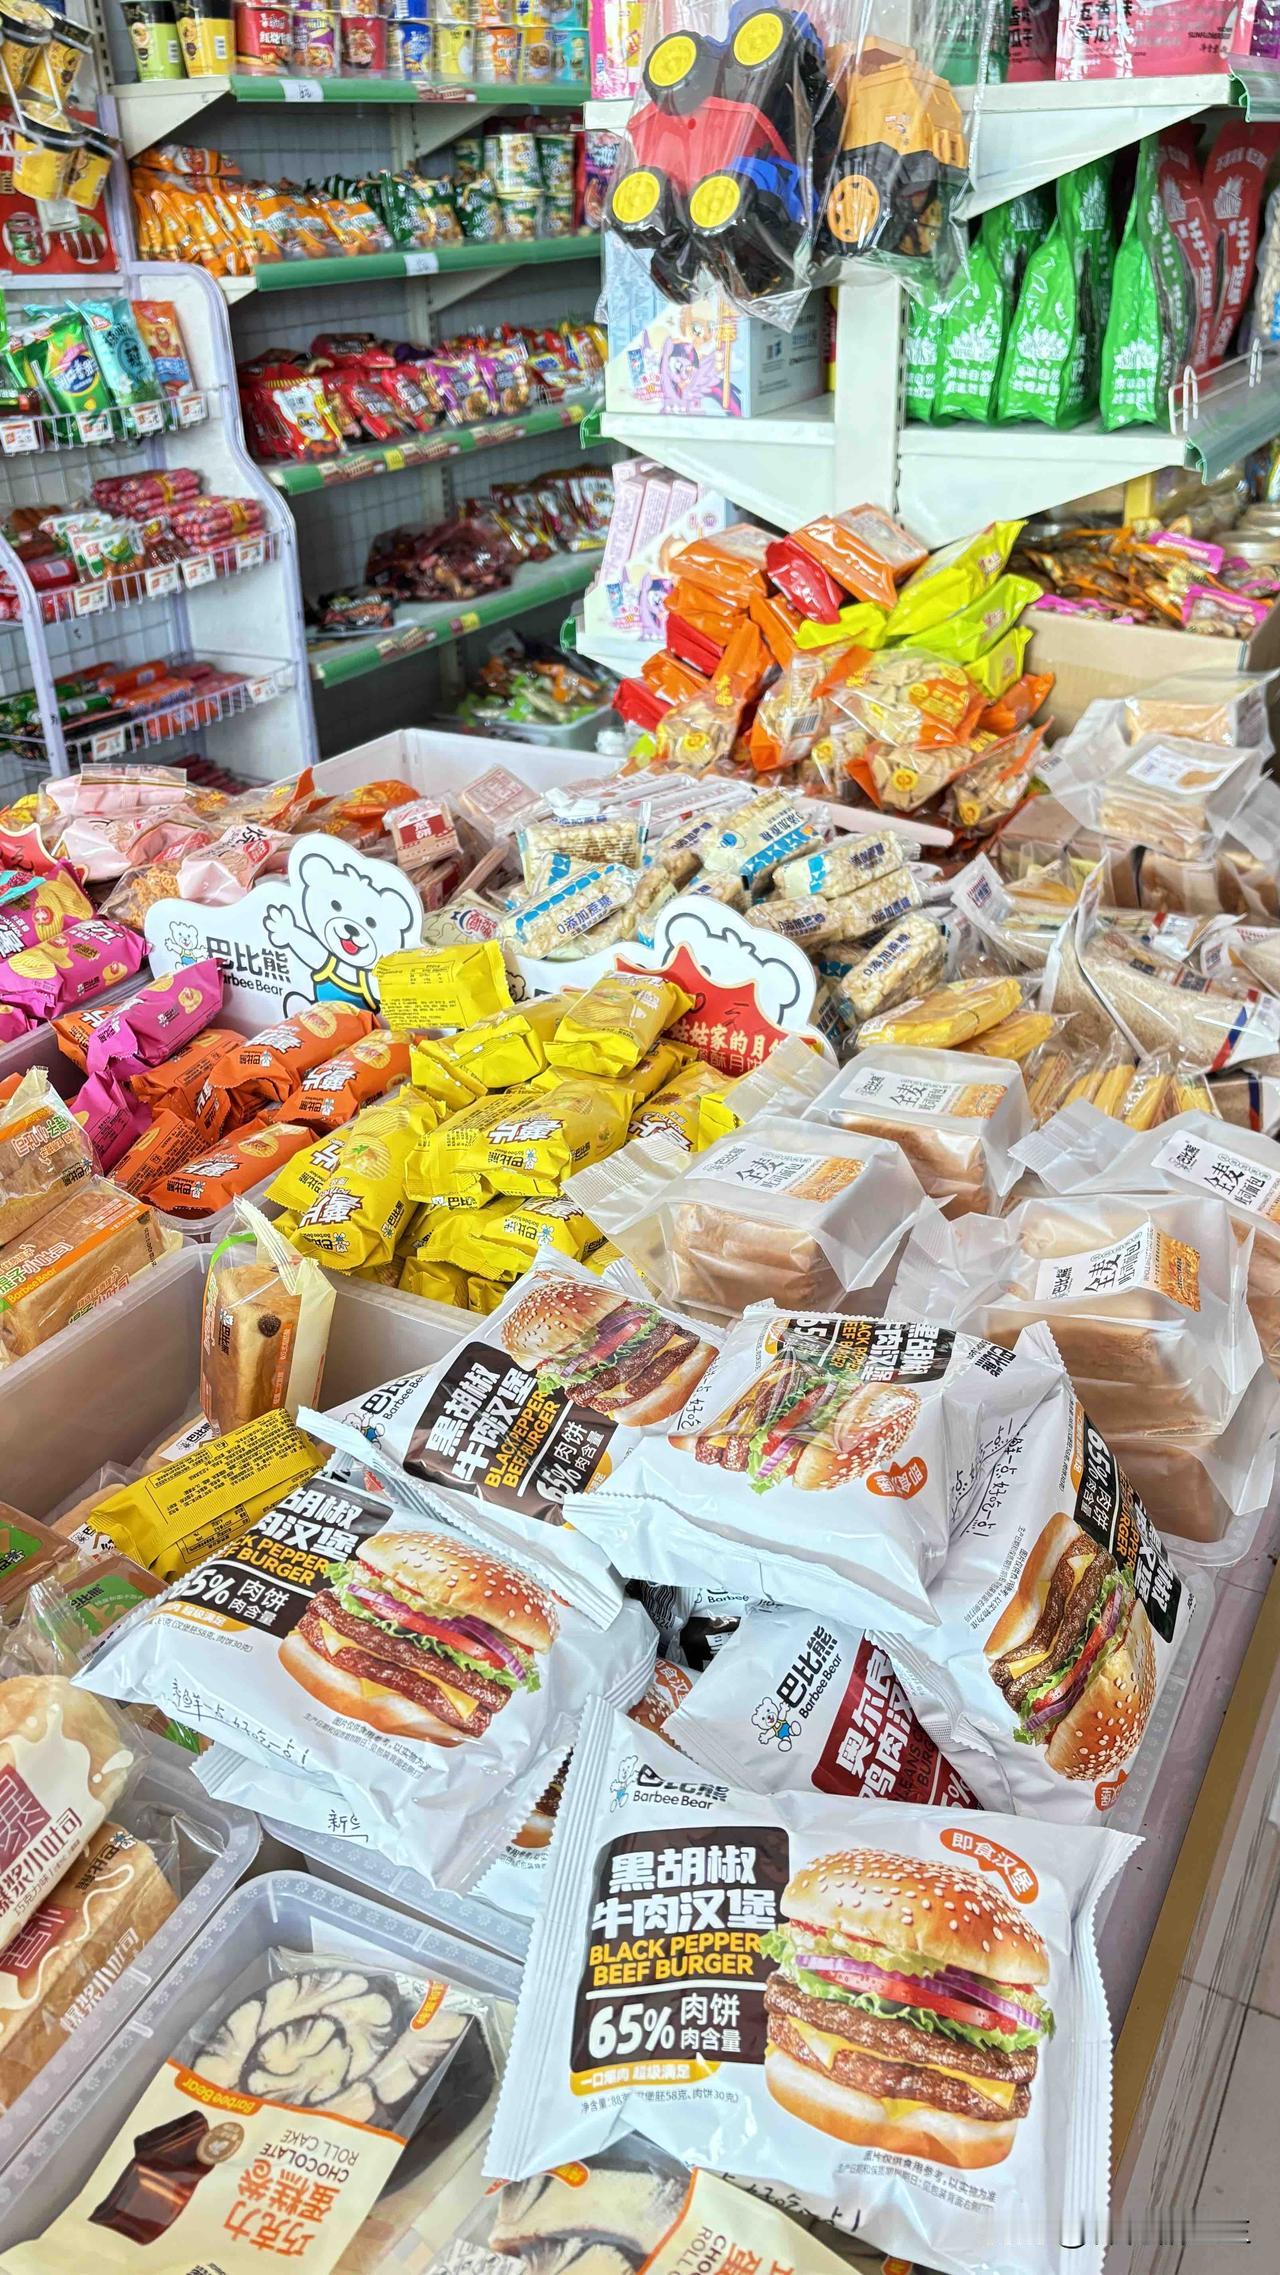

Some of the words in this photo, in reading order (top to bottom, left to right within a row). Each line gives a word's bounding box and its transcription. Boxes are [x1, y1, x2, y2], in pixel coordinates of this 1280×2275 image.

[556, 895, 614, 935] 0添加蔗糖
[206, 936, 290, 983] 巴比熊
[222, 972, 255, 992] arbee
[256, 978, 283, 995] Bear
[890, 1084, 927, 1107] 全麦
[488, 1151, 524, 1168] 巴比熊
[736, 1157, 784, 1184] 全麦
[760, 1163, 804, 1188] 吐司面包
[1204, 1162, 1244, 1195] 全麦
[1234, 1176, 1265, 1205] 吐司面包
[298, 1194, 365, 1229] 薯片
[1083, 1254, 1121, 1292] 全麦
[1118, 1240, 1140, 1286] 吐司面包
[7, 1278, 38, 1302] Barbee
[36, 1268, 56, 1285] Bear
[384, 1388, 414, 1420] Barbee
[425, 1362, 500, 1456] 黑胡椒
[452, 1367, 537, 1481] 牛肉汉堡
[484, 1436, 517, 1488] BLACK
[510, 1390, 549, 1442] PEPPER
[502, 1450, 530, 1488] BEEF
[524, 1401, 560, 1457] BURGER
[554, 1422, 588, 1465] 肉饼
[574, 1431, 605, 1472] 肉含量
[1088, 1428, 1111, 1484] 65%
[1082, 1480, 1097, 1518] 肉含量
[1096, 1487, 1112, 1532] 肉饼
[236, 1548, 317, 1586] BURGER
[257, 1536, 330, 1574] PEPPER
[228, 1598, 277, 1627] 肉含量
[238, 1579, 289, 1612] 肉饼
[776, 1625, 838, 1709] 巴比熊
[800, 1676, 829, 1720] Barbee
[824, 1653, 843, 1681] Bear
[836, 1649, 890, 1779] 奥尔良
[632, 1790, 680, 1806] Barbee
[680, 1795, 714, 1810] Bear
[75, 1842, 120, 1893] 巴比熊
[609, 1845, 757, 1894] 黑胡椒
[951, 1831, 1034, 1896] 即食汉堡
[15, 1875, 48, 1915] 巧克力味
[591, 1888, 776, 1939] 牛肉汉堡
[589, 1937, 665, 1967] BLACK
[670, 1932, 761, 1957] PEPPER
[592, 1961, 651, 1987] BEEF
[655, 1953, 754, 1979] BURGER
[680, 1992, 741, 2028] 肉饼
[588, 2003, 676, 2060] 65%
[680, 2027, 742, 2053] 肉含量
[182, 2079, 214, 2101] Bear
[212, 2092, 255, 2113] Barbee
[280, 2129, 319, 2150] CAKE
[323, 2140, 360, 2165] ROLL
[260, 2143, 349, 2183] CHOCOLATE
[237, 2159, 340, 2223] 蛋糕卷
[224, 2200, 315, 2256] 巧克力
